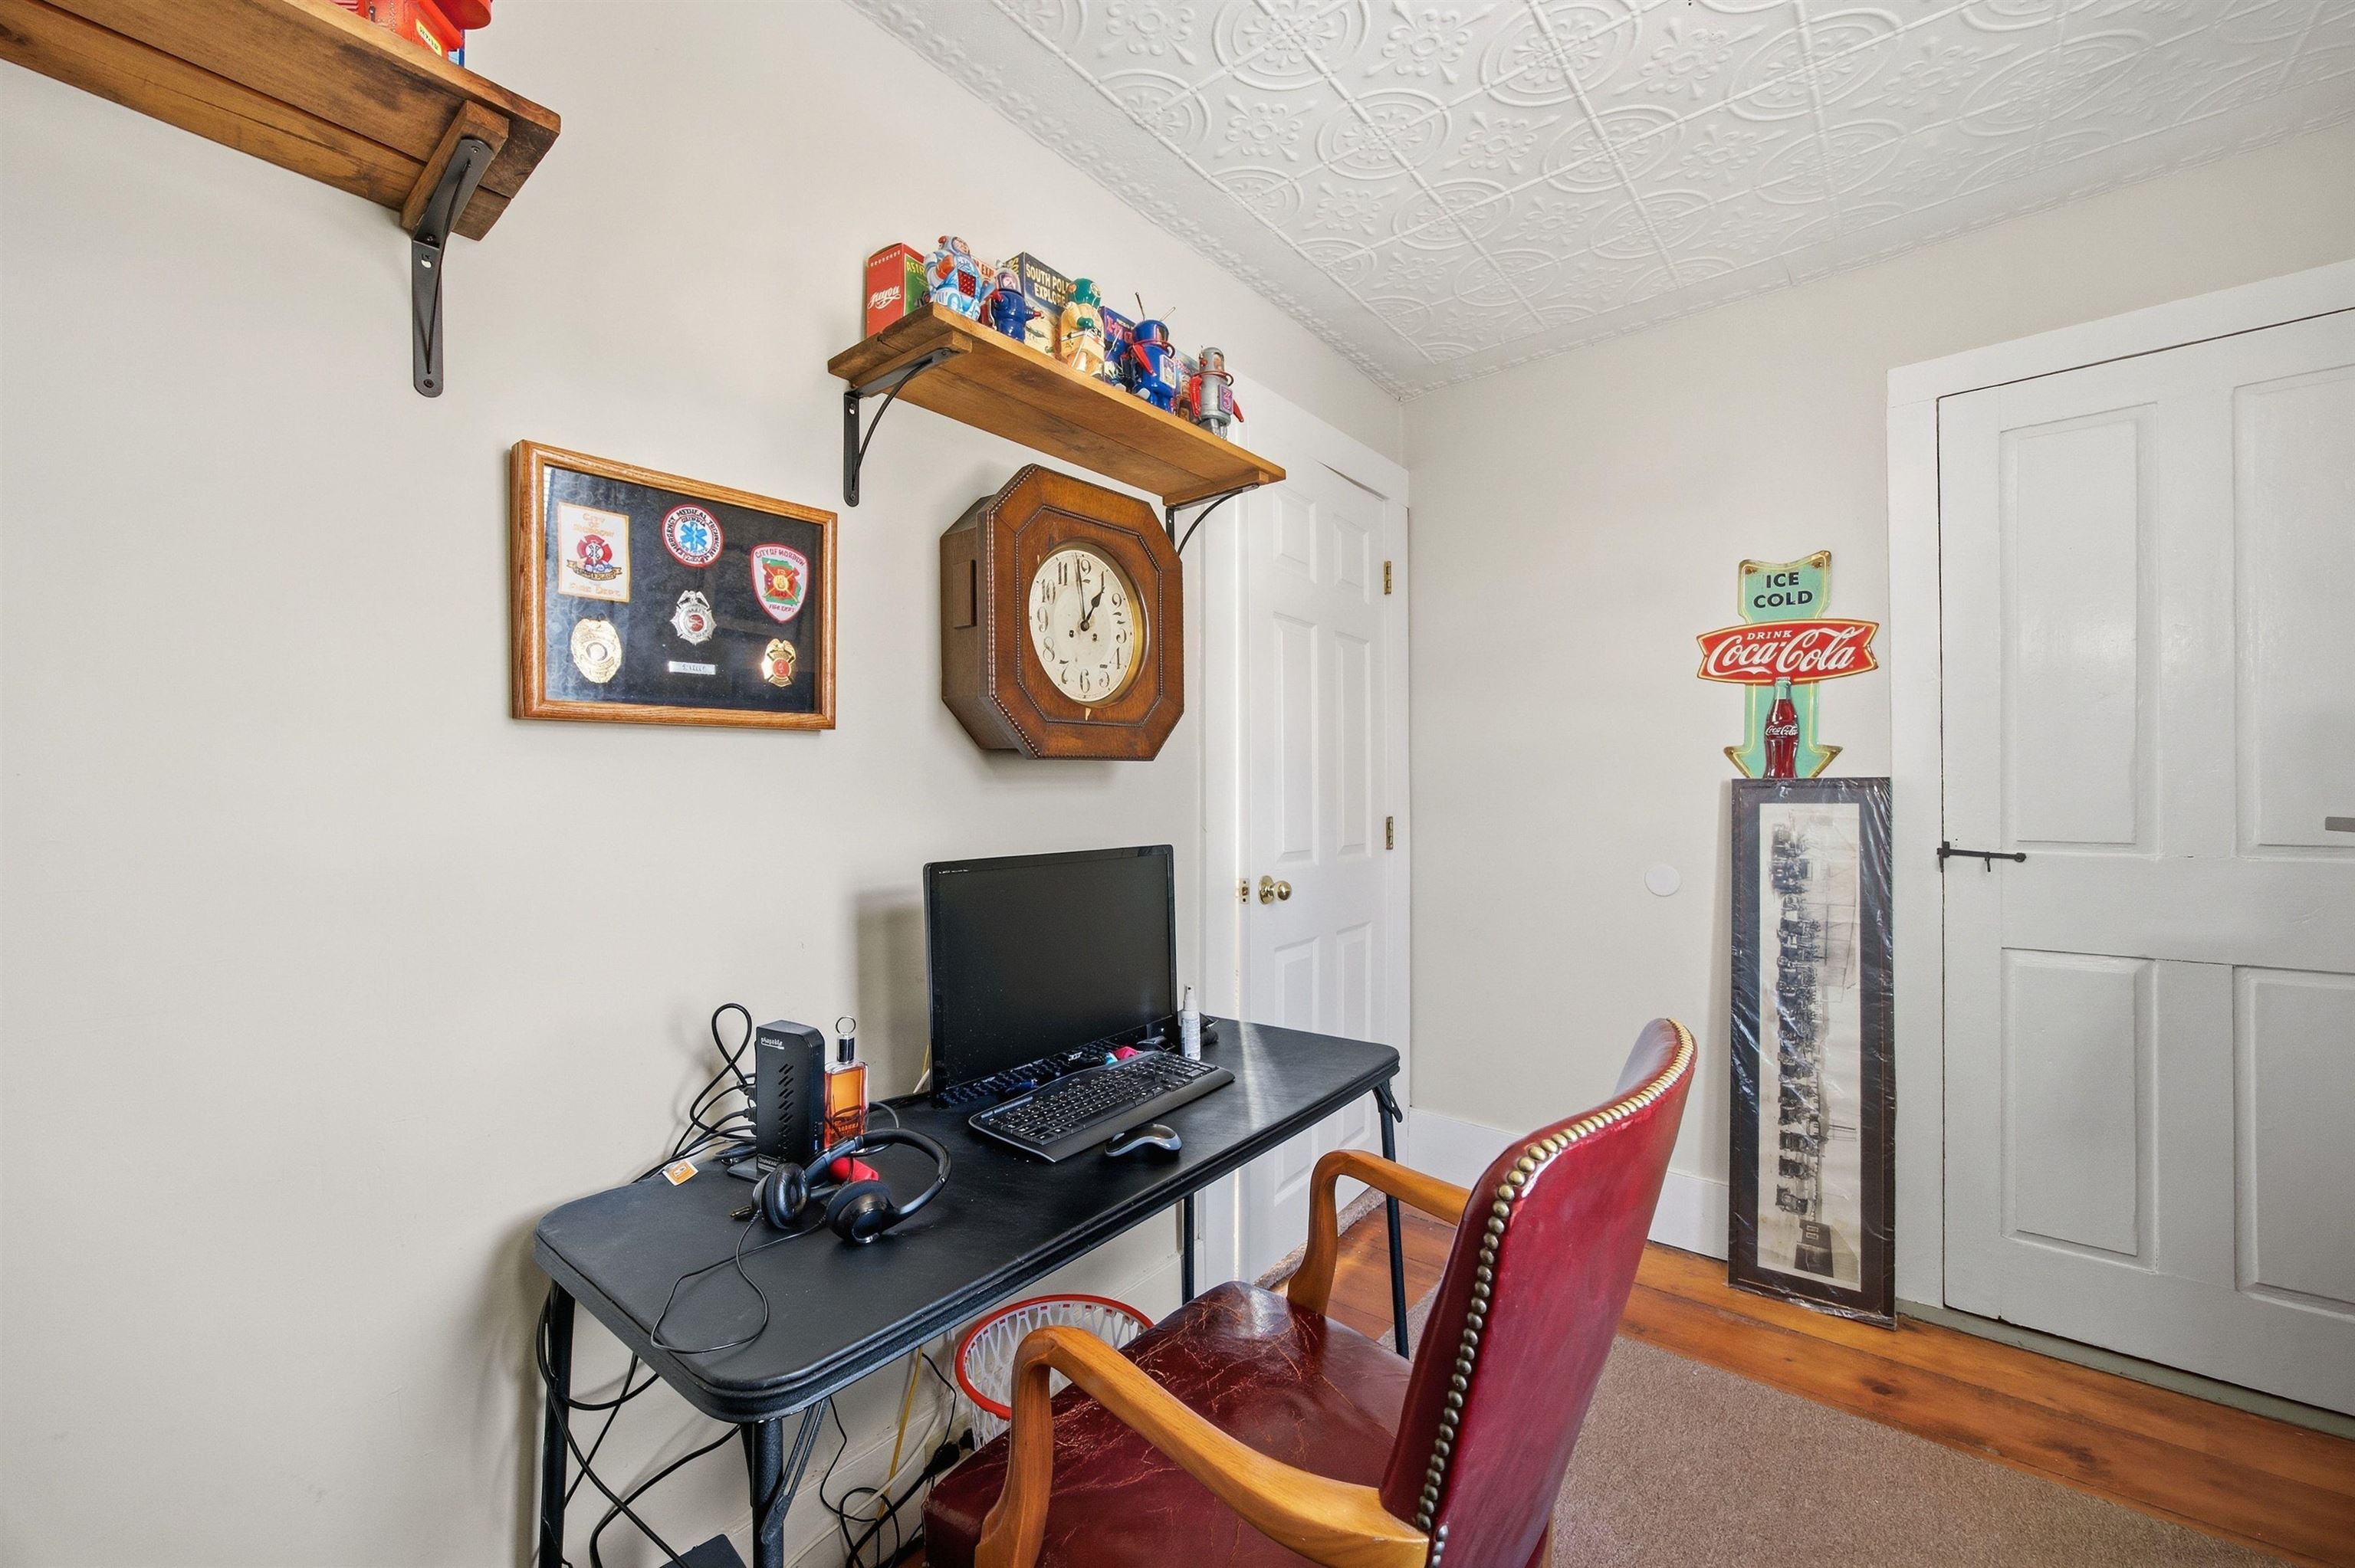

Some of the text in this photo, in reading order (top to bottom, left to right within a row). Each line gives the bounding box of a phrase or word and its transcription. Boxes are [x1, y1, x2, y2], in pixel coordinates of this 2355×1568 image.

[1026, 264, 1050, 287] SOUTH
[1221, 385, 1232, 410] 3
[755, 549, 769, 558] CITY
[1058, 561, 1068, 586] 11
[1765, 572, 1799, 589] ICE
[1041, 579, 1056, 605] 10
[1112, 592, 1122, 616] 2
[1753, 590, 1813, 609] COLD
[1036, 606, 1049, 632] 9
[1116, 621, 1127, 644] 3
[1746, 630, 1793, 641] DRINK
[1043, 636, 1055, 662] 8
[1109, 648, 1120, 669] 4
[1706, 625, 1866, 676] Coca-Cola
[1059, 659, 1069, 684] 7
[1079, 669, 1090, 693] 6
[1099, 664, 1110, 687] 5
